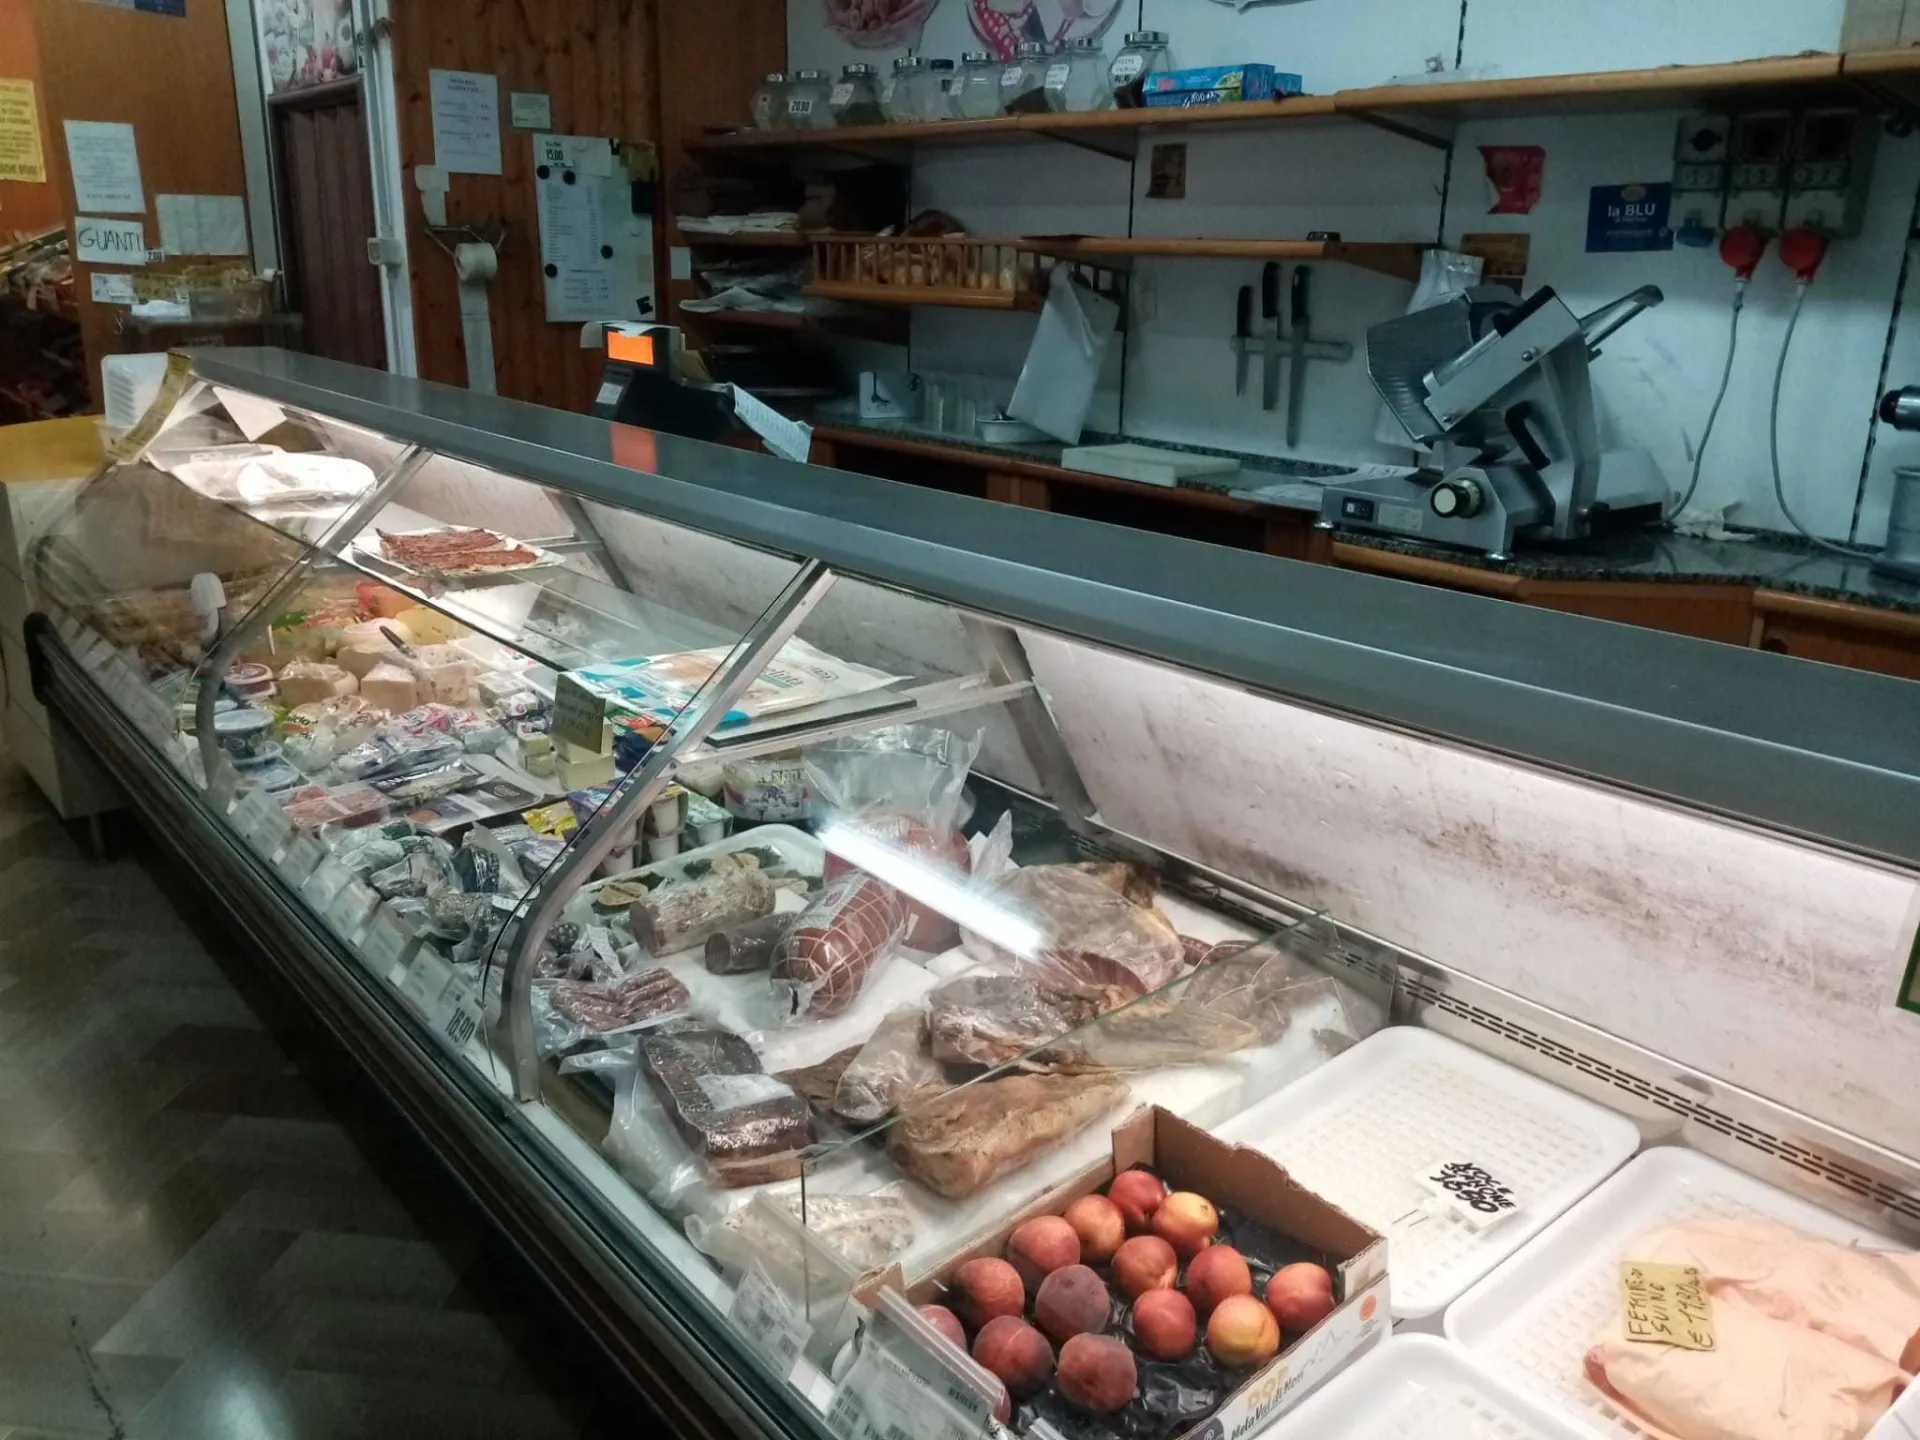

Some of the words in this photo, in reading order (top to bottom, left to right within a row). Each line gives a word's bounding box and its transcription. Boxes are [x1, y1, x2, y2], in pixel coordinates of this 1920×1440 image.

[1607, 204, 1621, 217] la
[1624, 203, 1657, 216] BLU
[78, 227, 142, 252] GUANTI
[1231, 1416, 1255, 1440] Mela
[1255, 1398, 1271, 1420] Val
